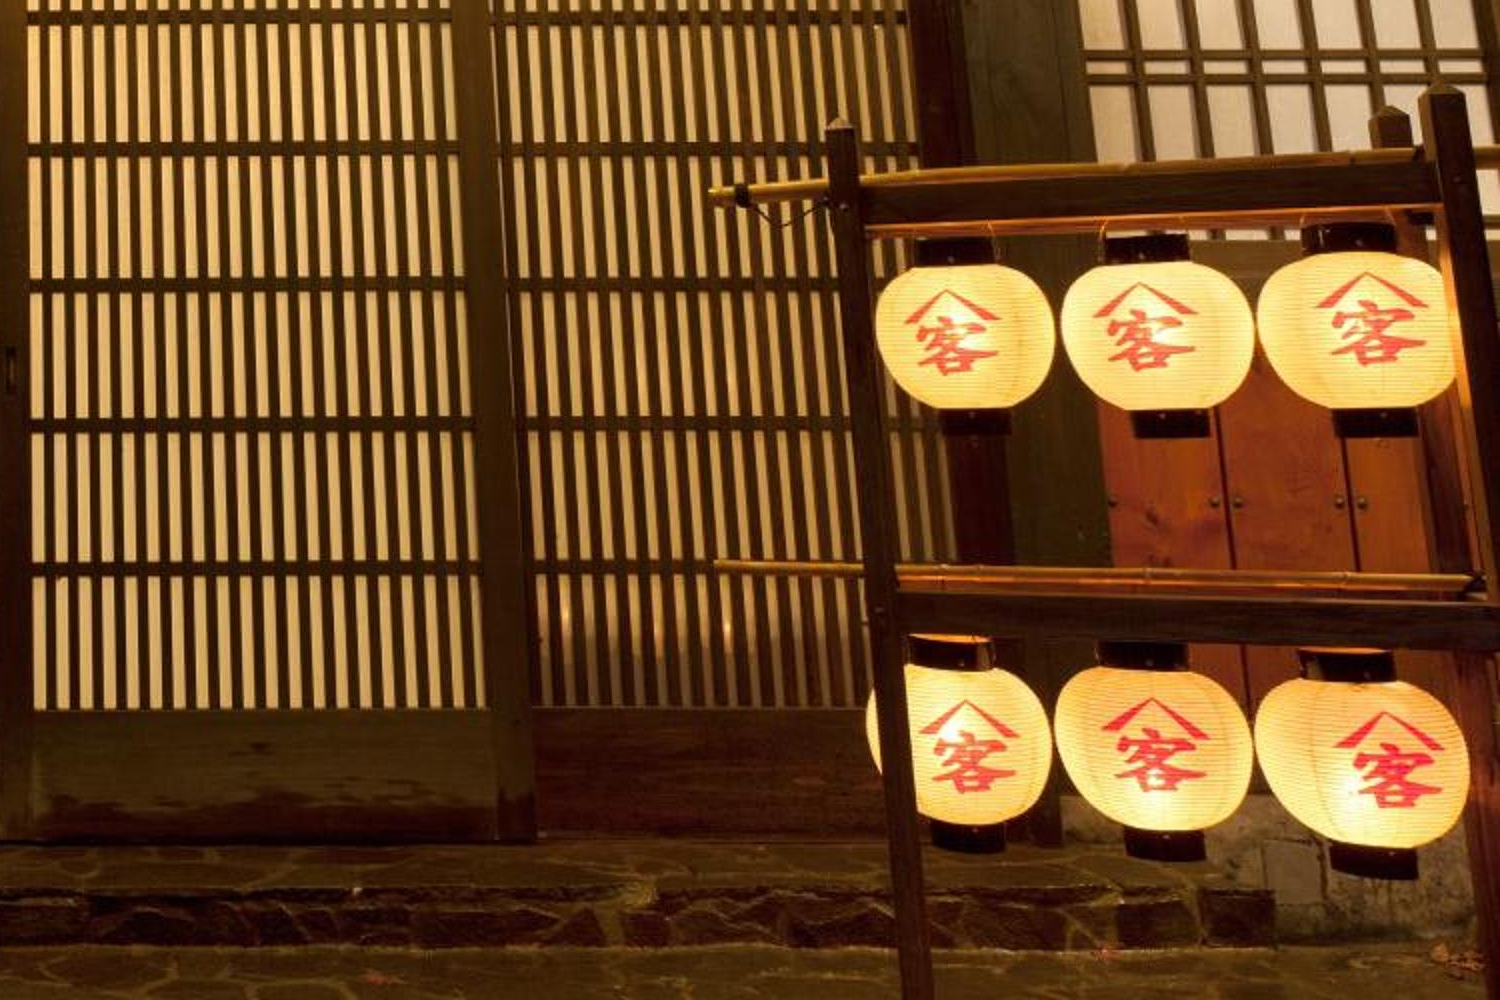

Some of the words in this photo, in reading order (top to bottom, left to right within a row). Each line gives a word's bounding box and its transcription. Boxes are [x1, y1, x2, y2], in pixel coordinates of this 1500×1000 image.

[916, 315, 998, 376] 客
[1106, 308, 1196, 373] 客
[1330, 299, 1428, 367] 客
[933, 730, 1017, 794] 客
[1114, 728, 1208, 793] 客
[1352, 743, 1444, 809] 客
